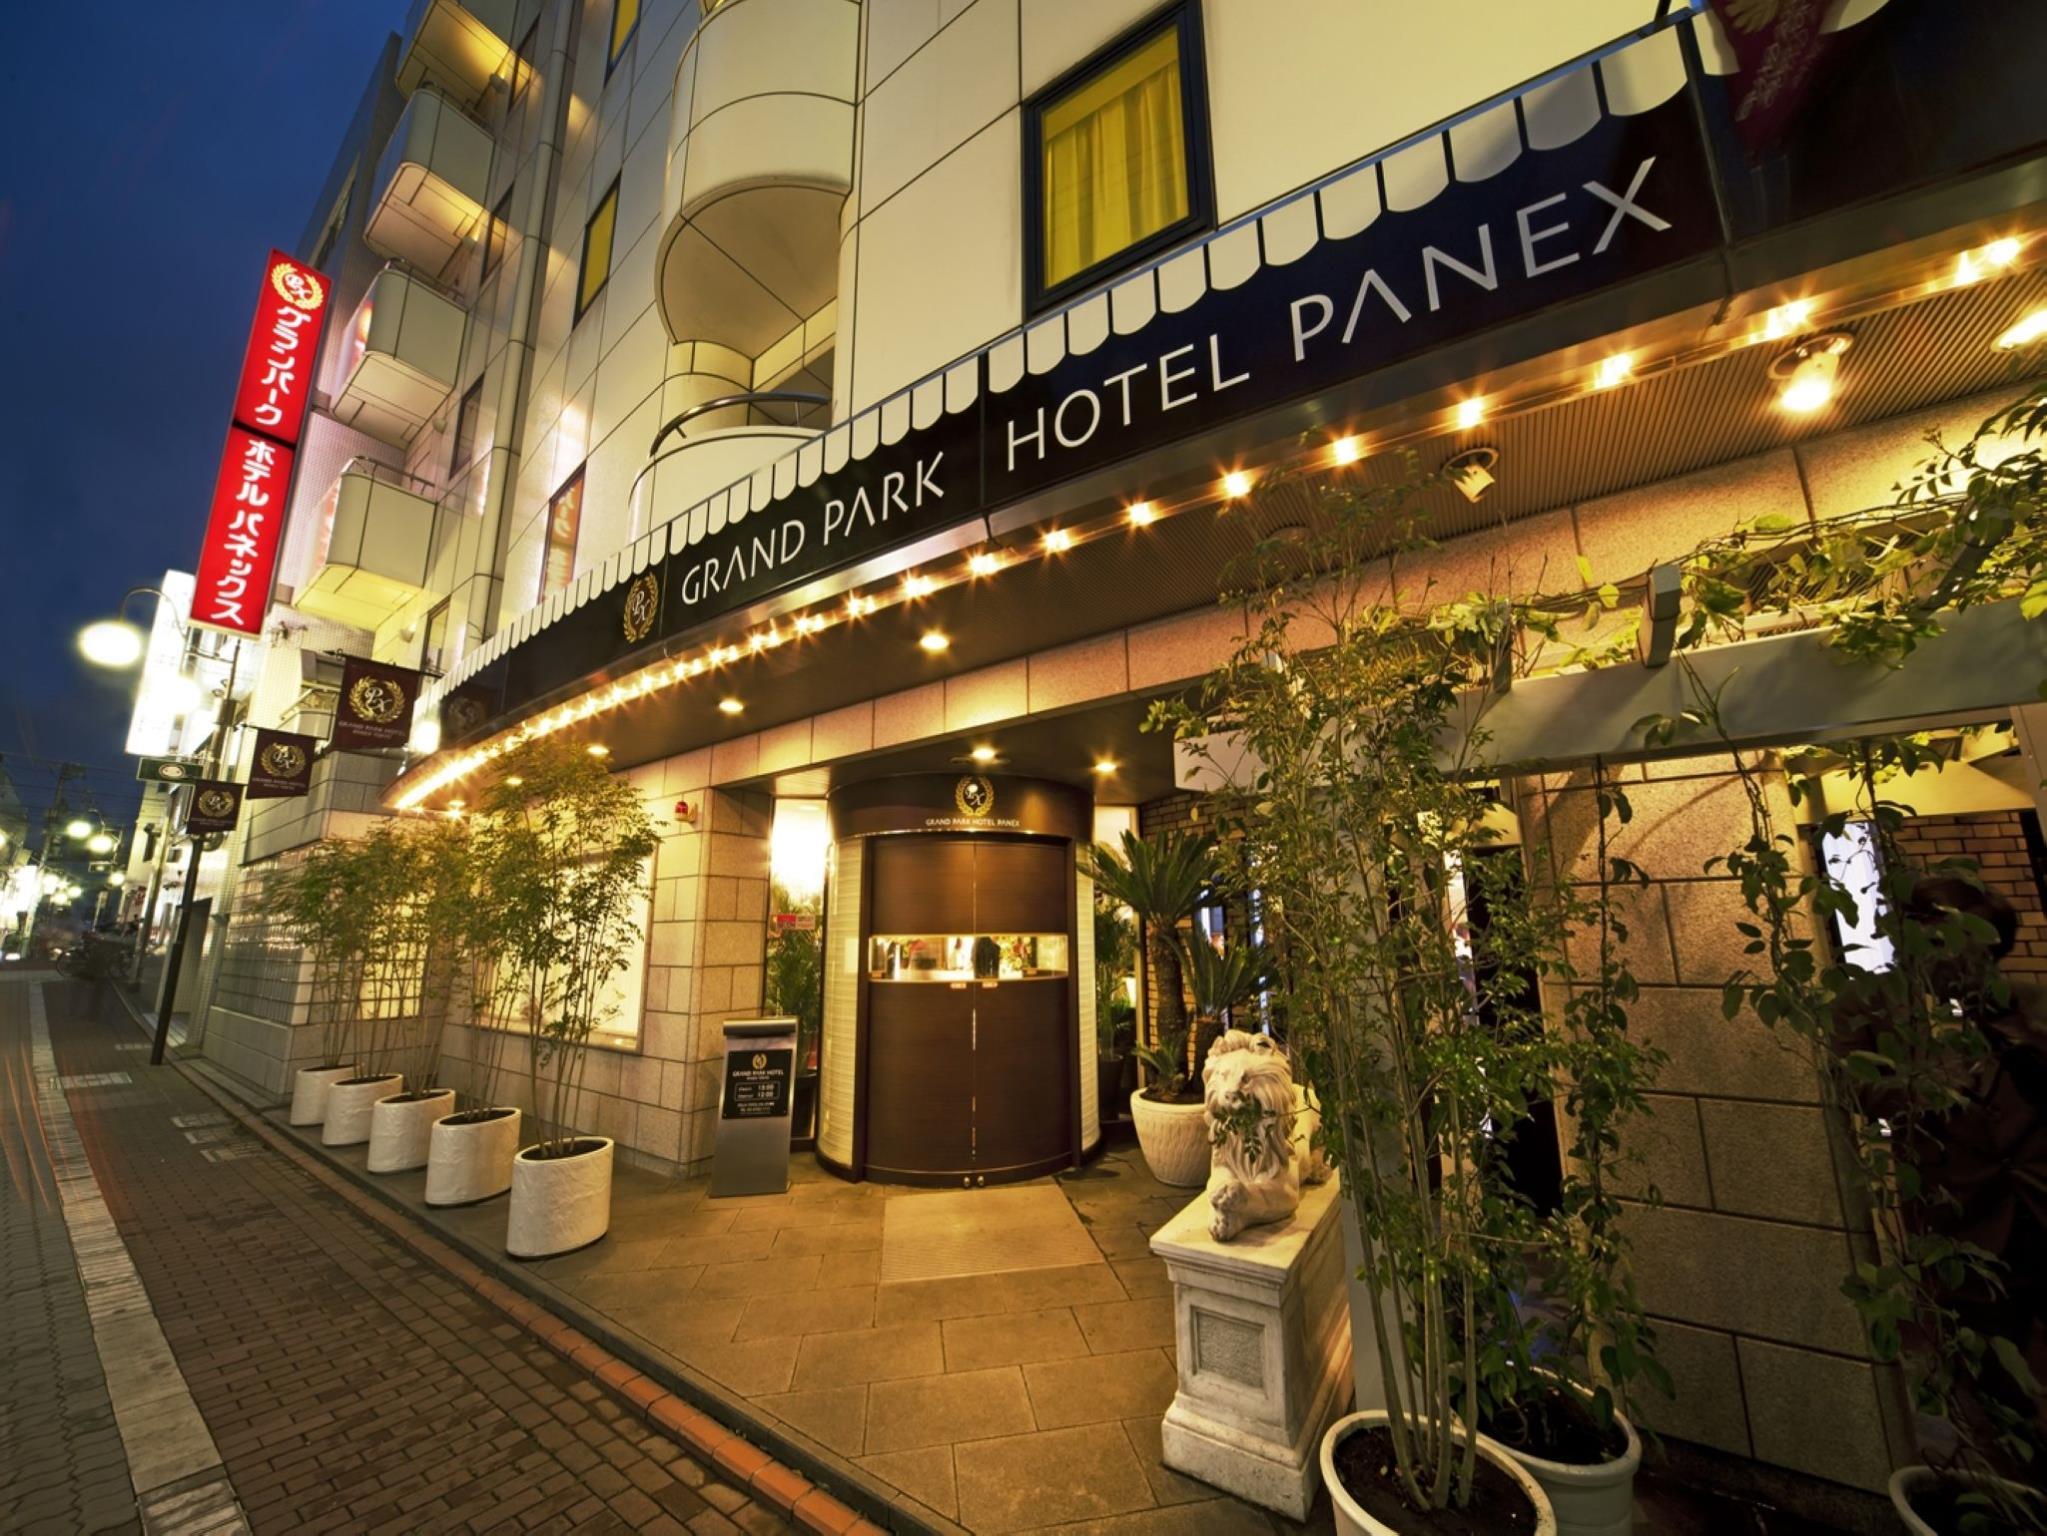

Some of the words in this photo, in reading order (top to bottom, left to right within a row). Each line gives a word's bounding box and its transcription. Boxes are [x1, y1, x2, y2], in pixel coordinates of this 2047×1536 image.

[254, 305, 312, 426] グランパーク
[682, 519, 805, 605] GRAND
[823, 451, 945, 546] PARK
[1006, 333, 1250, 471] HOTEL
[1290, 156, 1672, 362] PANEX
[925, 817, 951, 827] GRAND
[972, 818, 995, 827] HOTEL
